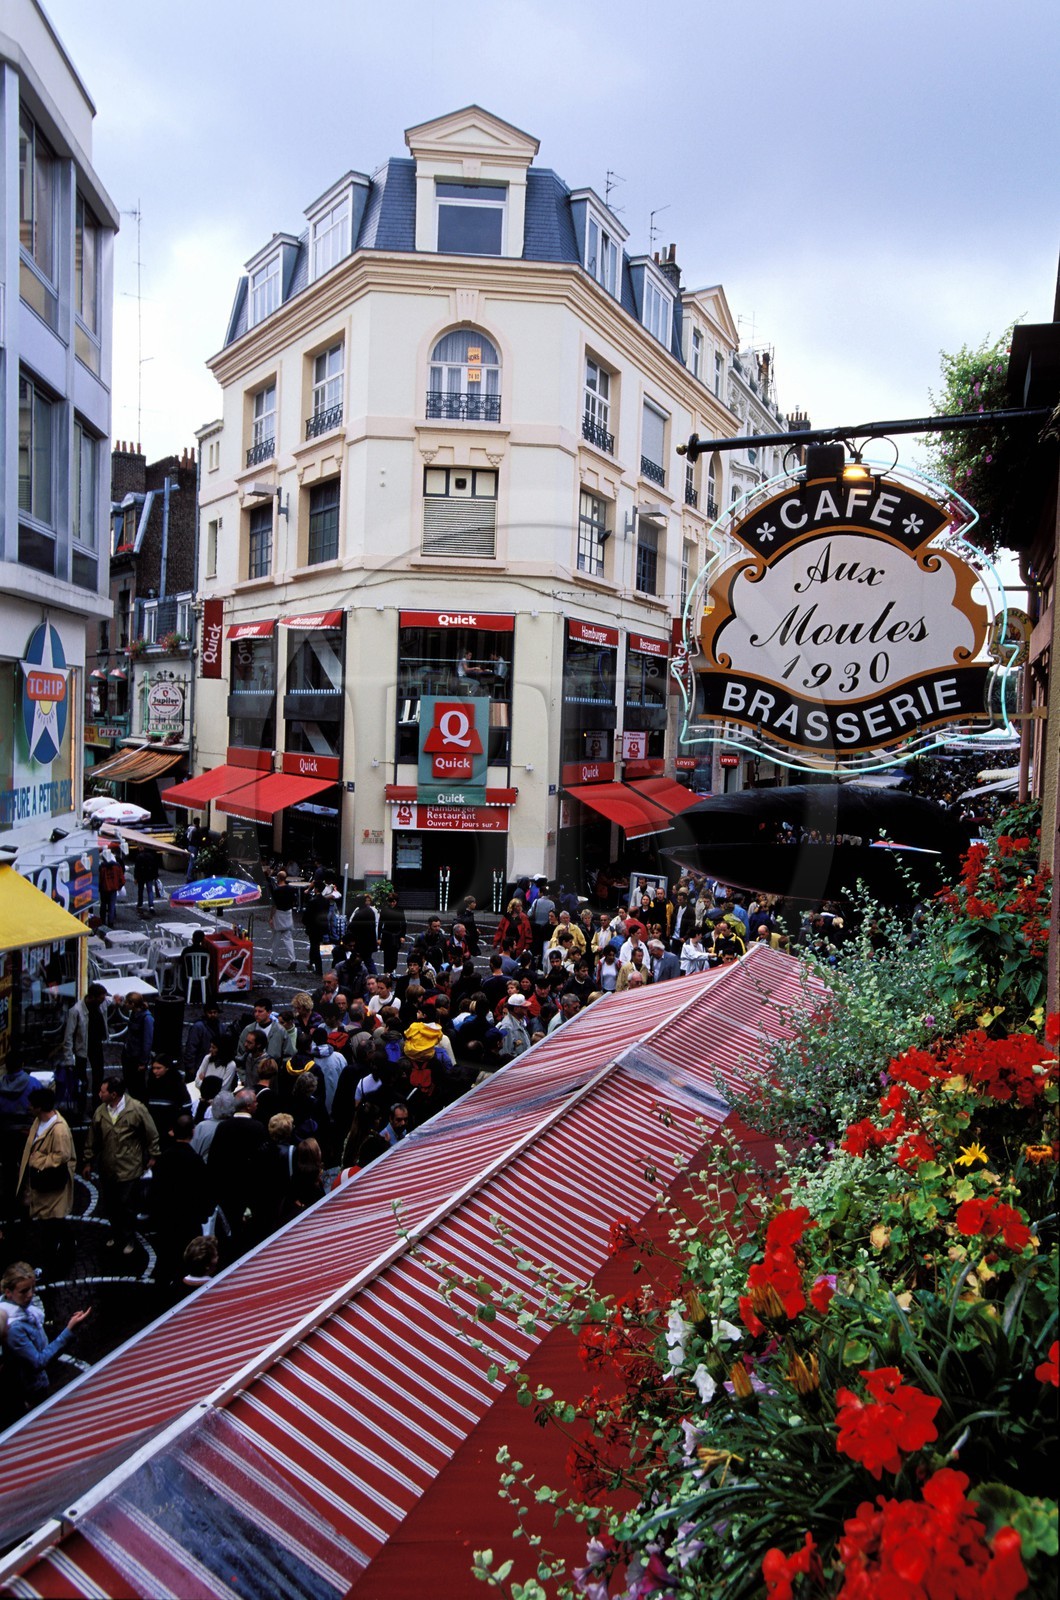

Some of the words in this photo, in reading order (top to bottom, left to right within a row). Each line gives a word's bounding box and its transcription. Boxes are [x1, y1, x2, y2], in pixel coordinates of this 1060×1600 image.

[779, 487, 901, 529] CAFE
[794, 541, 886, 593] Aux
[437, 614, 477, 626] Quick
[749, 601, 930, 648] Moules
[581, 625, 608, 643] Hamburger
[203, 623, 222, 663] Quick
[781, 651, 890, 693] 1930
[29, 678, 63, 695] TCHIP
[722, 678, 962, 744] BRASSERIE
[439, 711, 471, 748] Q
[300, 758, 318, 773] Quick
[435, 758, 471, 769] Quick
[582, 766, 600, 781] Quick
[437, 793, 465, 804] Quick
[427, 805, 476, 813] Hamburger
[427, 811, 476, 819] Restaurant
[461, 821, 479, 829] jours
